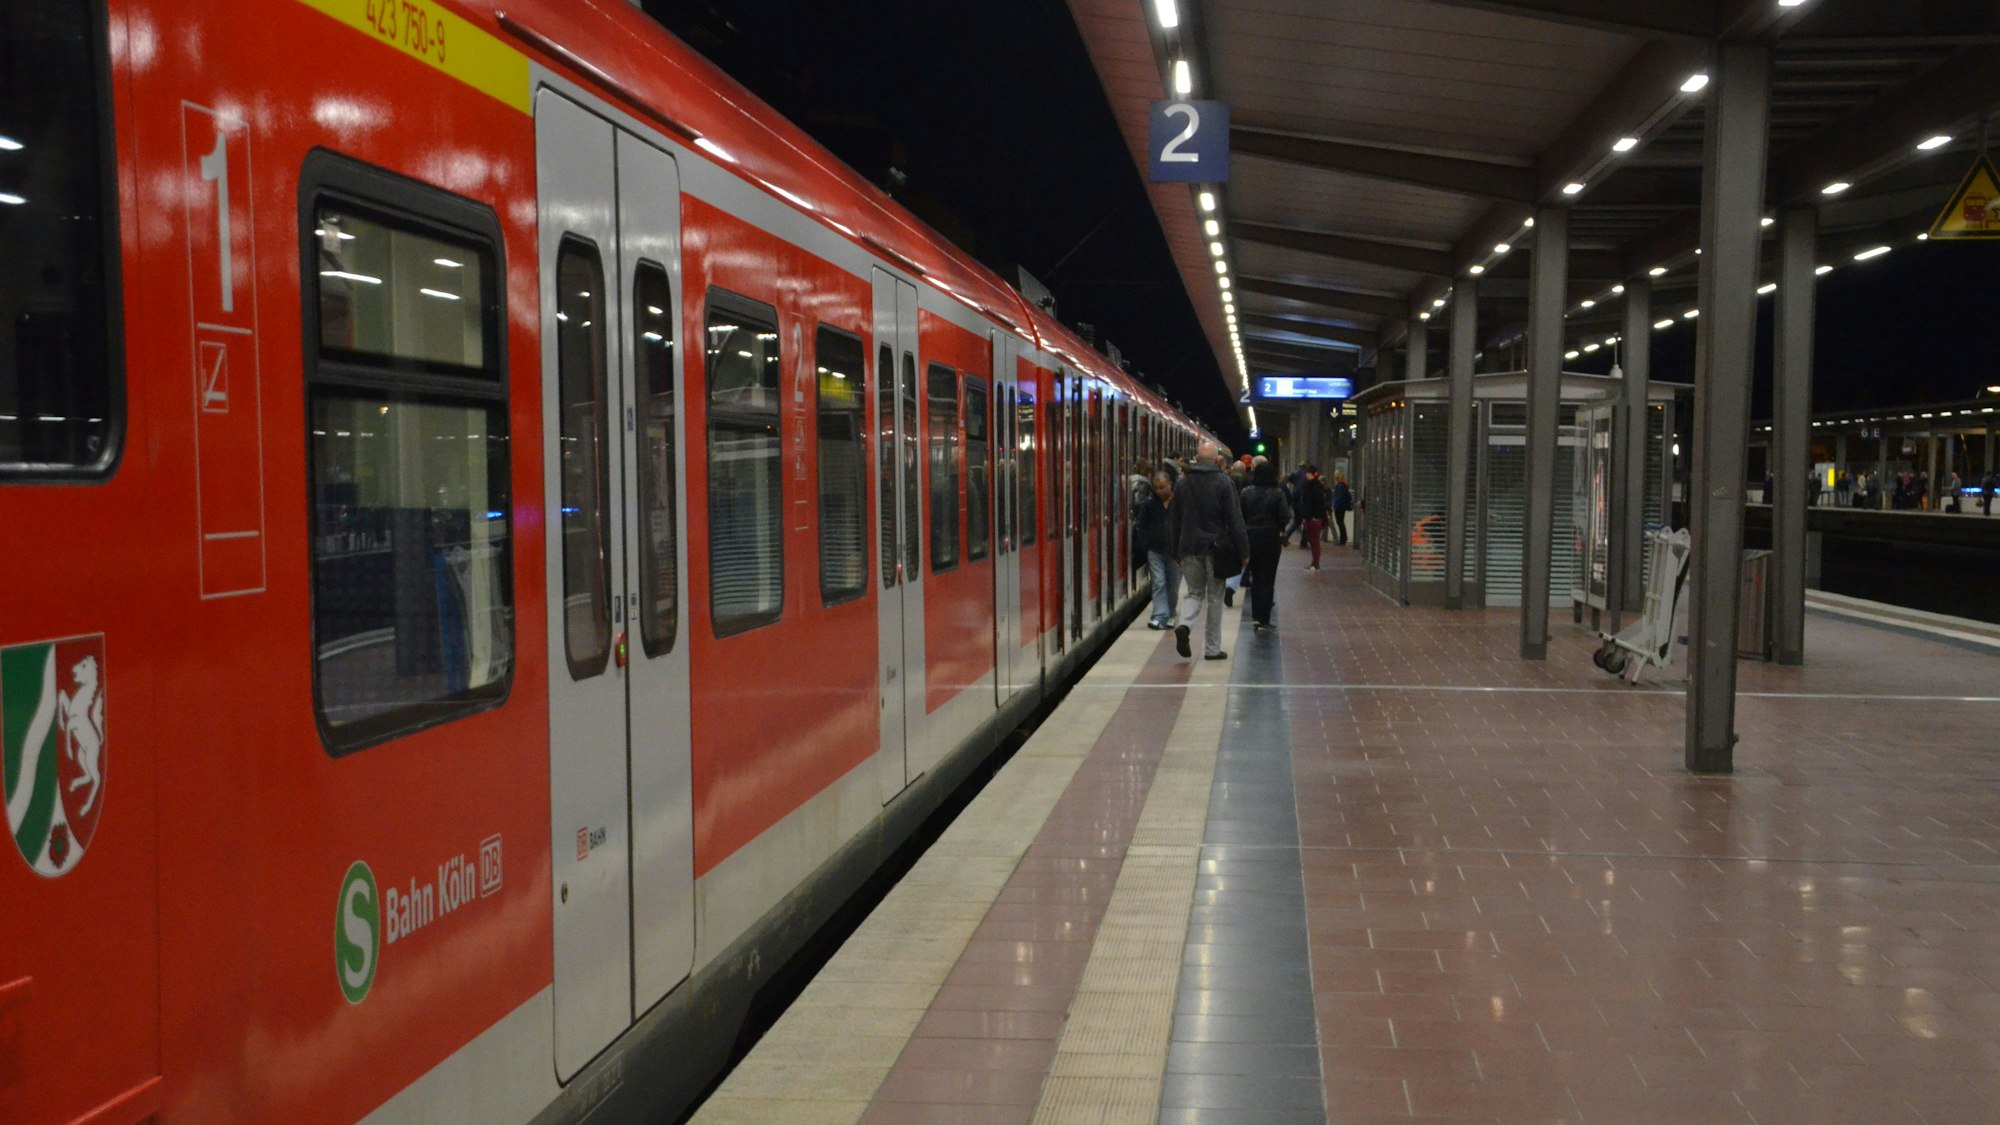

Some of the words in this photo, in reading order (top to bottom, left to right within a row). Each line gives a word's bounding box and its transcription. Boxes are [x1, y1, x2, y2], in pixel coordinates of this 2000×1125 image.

[402, 1, 446, 64] 750-9
[1160, 103, 1200, 162] 2
[201, 130, 233, 313] 1
[794, 322, 804, 402] 2
[1264, 383, 1271, 392] 2
[1240, 388, 1250, 403] 2
[1250, 429, 1257, 437] 2
[343, 878, 373, 988] S
[386, 875, 434, 945] Bahn
[438, 853, 476, 917] Köln
[481, 841, 501, 890] DB
